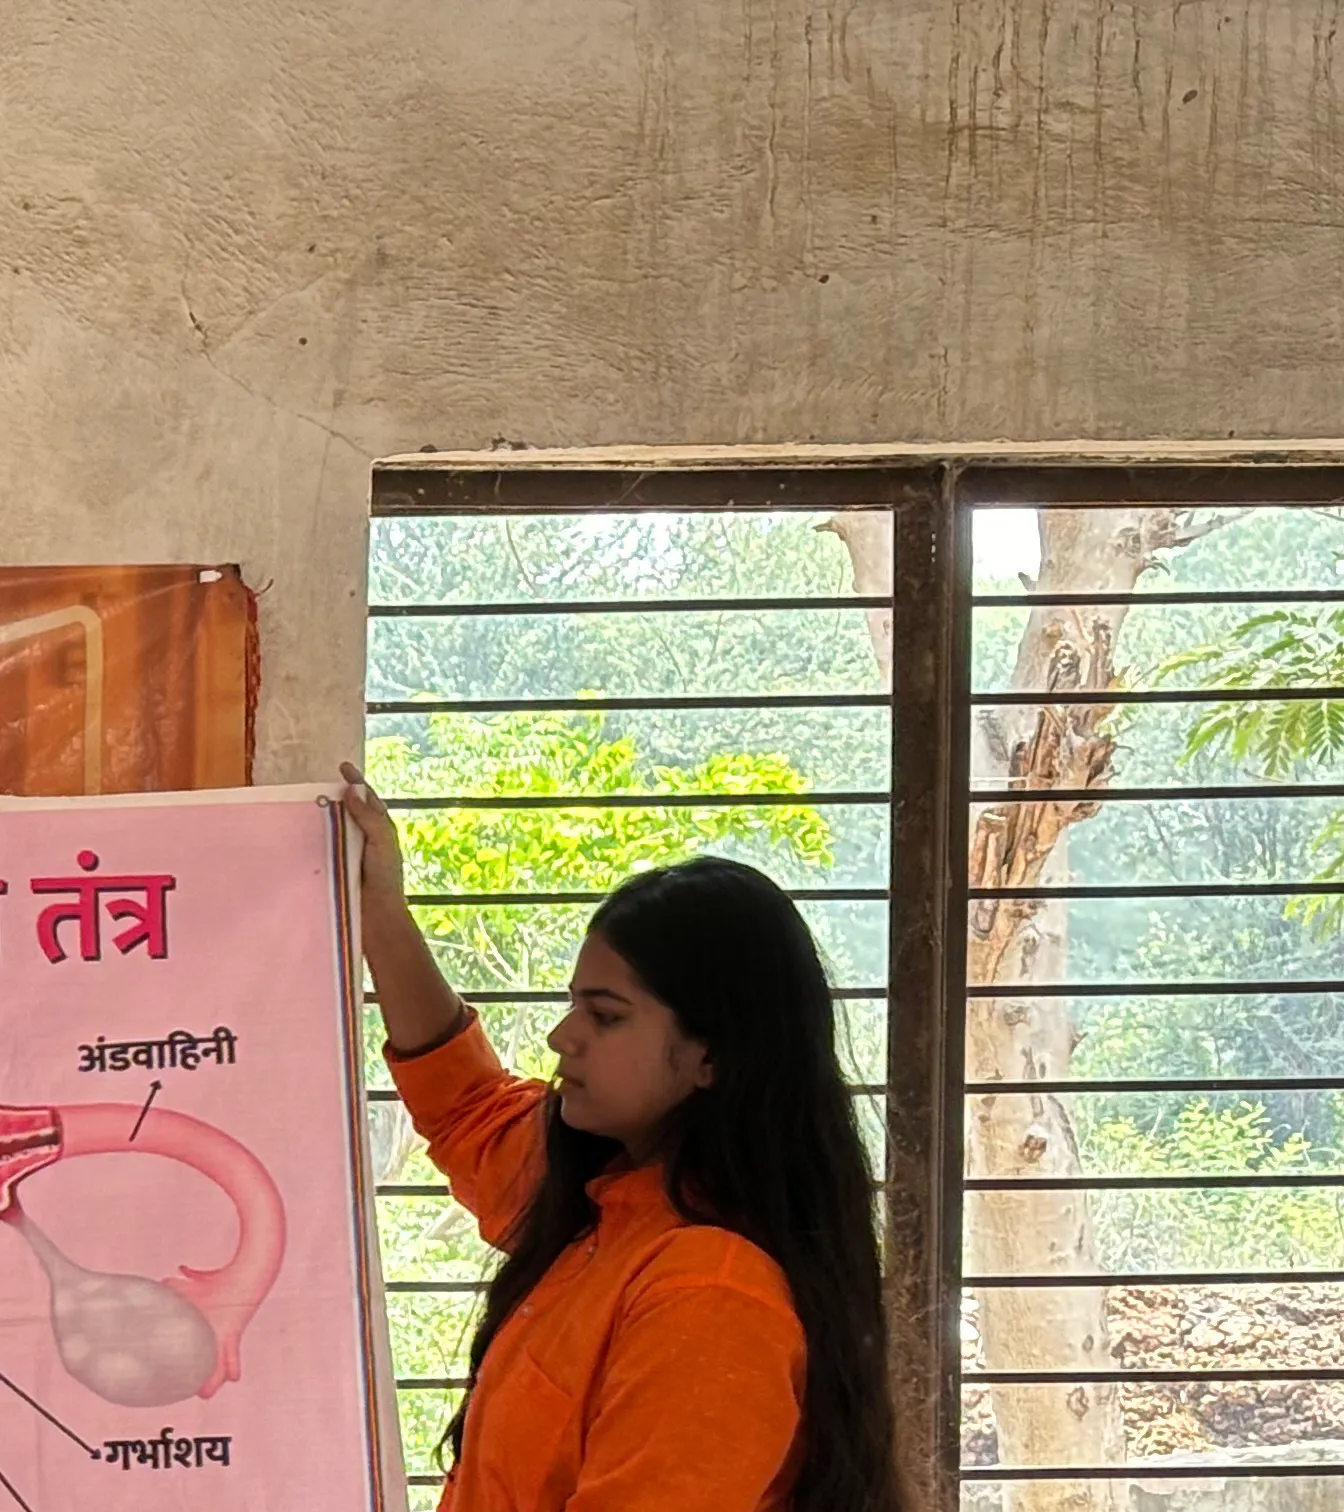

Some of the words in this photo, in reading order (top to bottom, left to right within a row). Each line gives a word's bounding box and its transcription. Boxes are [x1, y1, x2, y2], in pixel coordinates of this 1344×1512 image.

[30, 849, 176, 963] तंत्र
[78, 1026, 238, 1073] अंडवाहिनी
[103, 1427, 232, 1470] गर्भाशय
